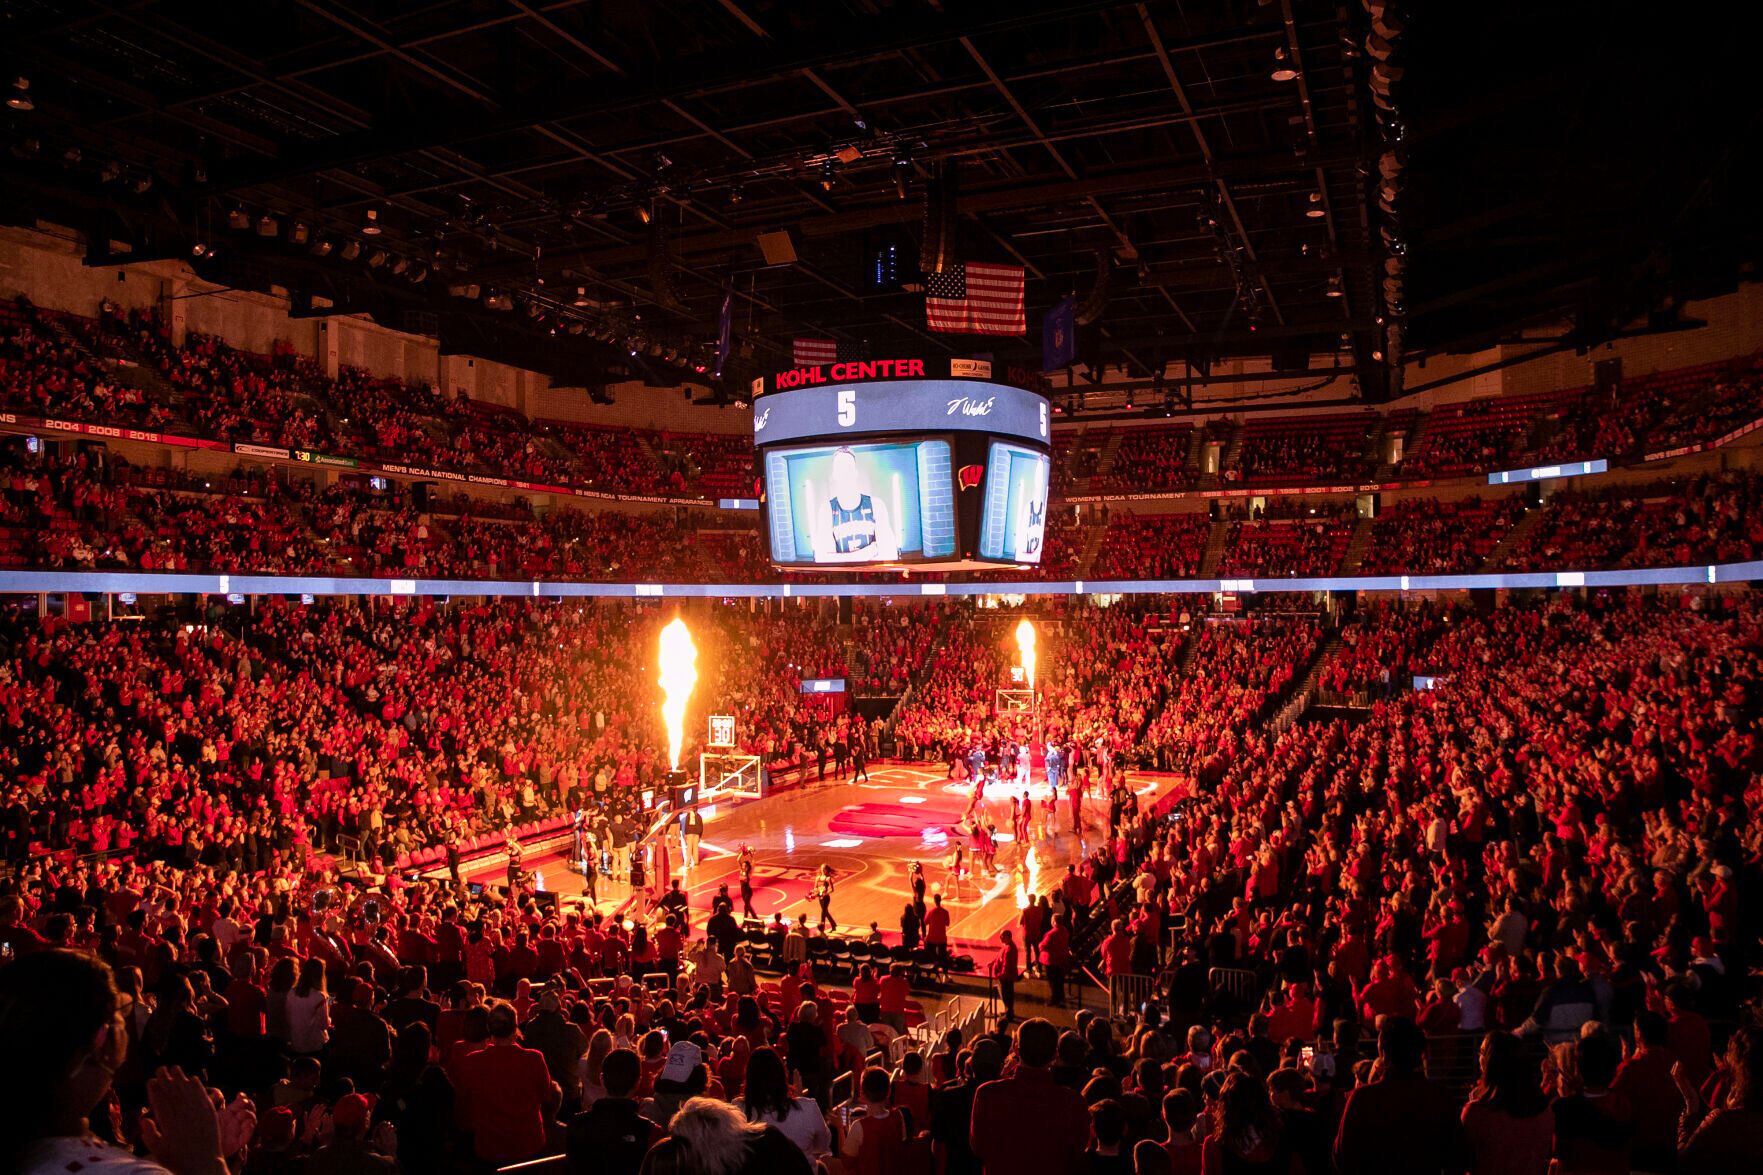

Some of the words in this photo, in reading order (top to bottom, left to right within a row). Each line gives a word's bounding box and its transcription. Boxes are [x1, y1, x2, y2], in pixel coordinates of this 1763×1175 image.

[777, 369, 826, 389] KOHL
[831, 359, 925, 381] CENTER
[838, 390, 855, 427] 5
[45, 419, 80, 432] 2004
[1040, 402, 1046, 437] 5
[88, 425, 121, 437] 2008
[129, 431, 158, 441] 2015
[382, 464, 407, 473] MEN'S
[408, 467, 430, 476] NCAA
[431, 470, 466, 481] NATIONAL
[468, 475, 507, 486] CHAMPIONS
[617, 494, 667, 503] TOURNAMENT
[669, 498, 714, 506] APPEARANCES
[1065, 495, 1101, 503] WOMEN'S
[1103, 494, 1126, 502] NCAA
[1127, 492, 1186, 500] TOURNAMENT
[715, 728, 730, 744] 30
